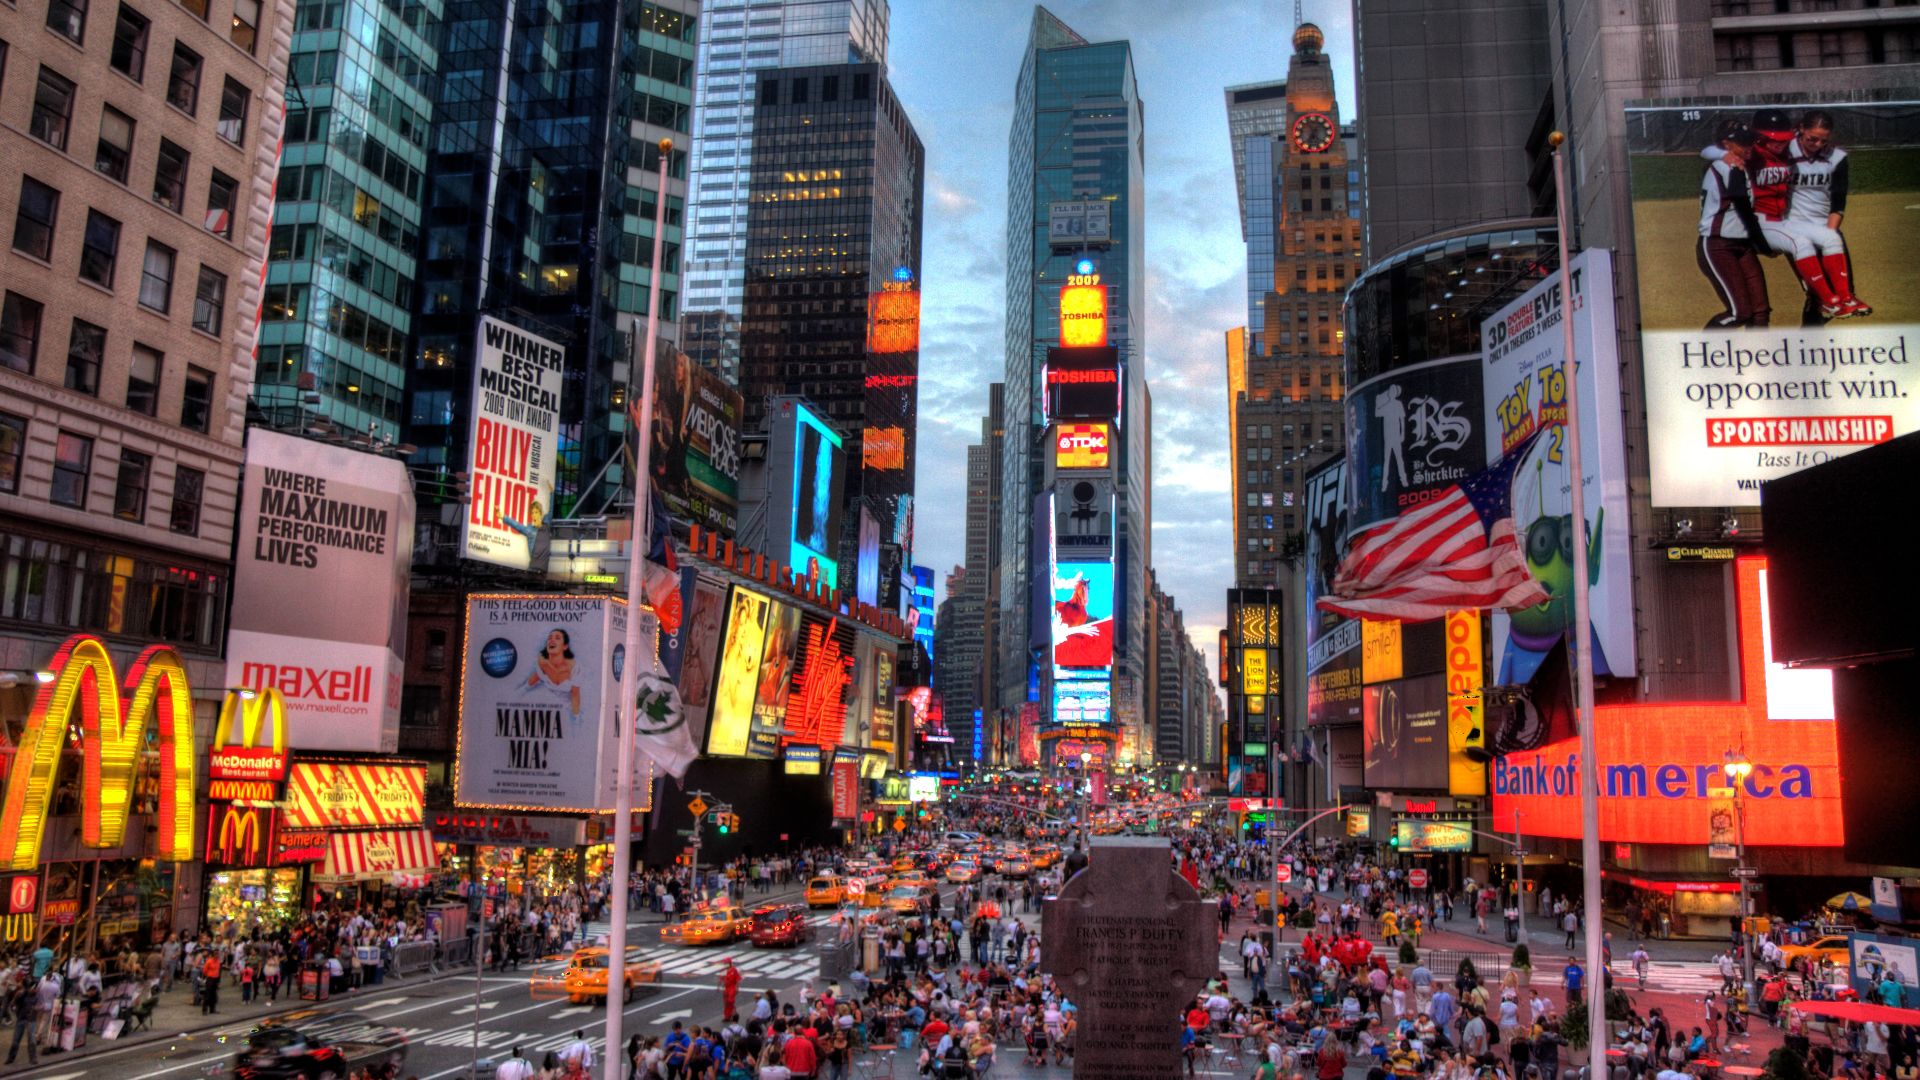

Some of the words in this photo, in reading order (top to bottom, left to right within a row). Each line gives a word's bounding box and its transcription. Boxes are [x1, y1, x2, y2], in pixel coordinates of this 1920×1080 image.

[1682, 111, 1700, 121] 215
[1068, 275, 1100, 286] 2009
[1063, 312, 1104, 320] TOSHIBA
[1488, 321, 1507, 349] 3D
[1507, 301, 1533, 326] DOUBLE
[1534, 267, 1581, 320] EVET
[1507, 313, 1534, 337] FEATURE
[486, 321, 562, 373] WINNER
[1489, 347, 1502, 364] ONLY
[1503, 343, 1509, 357] IN
[1510, 327, 1535, 352] THEATRES
[1537, 323, 1541, 335] 2
[1681, 339, 1792, 375] Helped
[1800, 336, 1909, 373] injured
[501, 353, 544, 386] BEST
[1048, 371, 1117, 384] TOSHIBA
[480, 367, 558, 413] MUSICAL
[1686, 380, 1832, 410] opponent
[1839, 371, 1908, 399] win.
[484, 391, 504, 417] 2009
[507, 399, 525, 423] TONY
[526, 406, 552, 432] AWARD
[1496, 373, 1532, 435] TOY
[685, 403, 737, 456] MELROSE
[1503, 418, 1532, 453] STORY
[1712, 419, 1887, 444] SPORTSMANSHIP
[475, 416, 532, 482] BILLY
[531, 435, 542, 470] MUSICAL
[1070, 437, 1104, 448] TDK
[1548, 422, 1563, 465] 2
[710, 443, 740, 480] PLACE
[1757, 451, 1790, 468] Pass
[1795, 451, 1808, 467] It
[265, 467, 326, 496] WHERE
[529, 471, 539, 485] THE
[1413, 466, 1465, 485] Sheckler
[471, 471, 538, 535] ELLIOT
[1398, 489, 1441, 506] 2009
[260, 487, 387, 535] MAXIMUM
[258, 516, 385, 554] PERFORMANCE
[1058, 535, 1109, 546] CHEVROLET
[255, 536, 318, 568] LIVES
[489, 611, 498, 621] IS
[501, 611, 508, 621] A
[502, 600, 556, 611] FEEL-GOOD
[559, 601, 602, 611] MUSICAL
[1366, 629, 1397, 659] smile?
[1247, 667, 1264, 677] LION
[1352, 667, 1360, 684] 19
[1449, 610, 1478, 720] odak
[242, 662, 372, 702] maxell
[1246, 678, 1264, 688] KING
[286, 702, 368, 715] ww.maxell.com
[495, 708, 563, 739] MAMMA
[211, 755, 282, 769] McDonald's
[508, 739, 549, 769] MIA!
[222, 769, 269, 778] Restaurant
[1496, 754, 1548, 795] Bank
[1553, 754, 1576, 795] of
[1597, 762, 1813, 799] merica
[323, 792, 354, 801] FRIDAY'S
[380, 792, 408, 801] FRIDAY'S
[436, 815, 532, 833] DIGITAL
[1398, 813, 1473, 821] MARQUIS
[1076, 927, 1126, 939] FRANCIS
[1142, 929, 1185, 940] DUFFY
[1138, 957, 1169, 966] PRIEST
[1135, 1024, 1170, 1032] SERVICE
[1110, 1041, 1127, 1049] AND
[1131, 1041, 1171, 1050] COUNTRY
